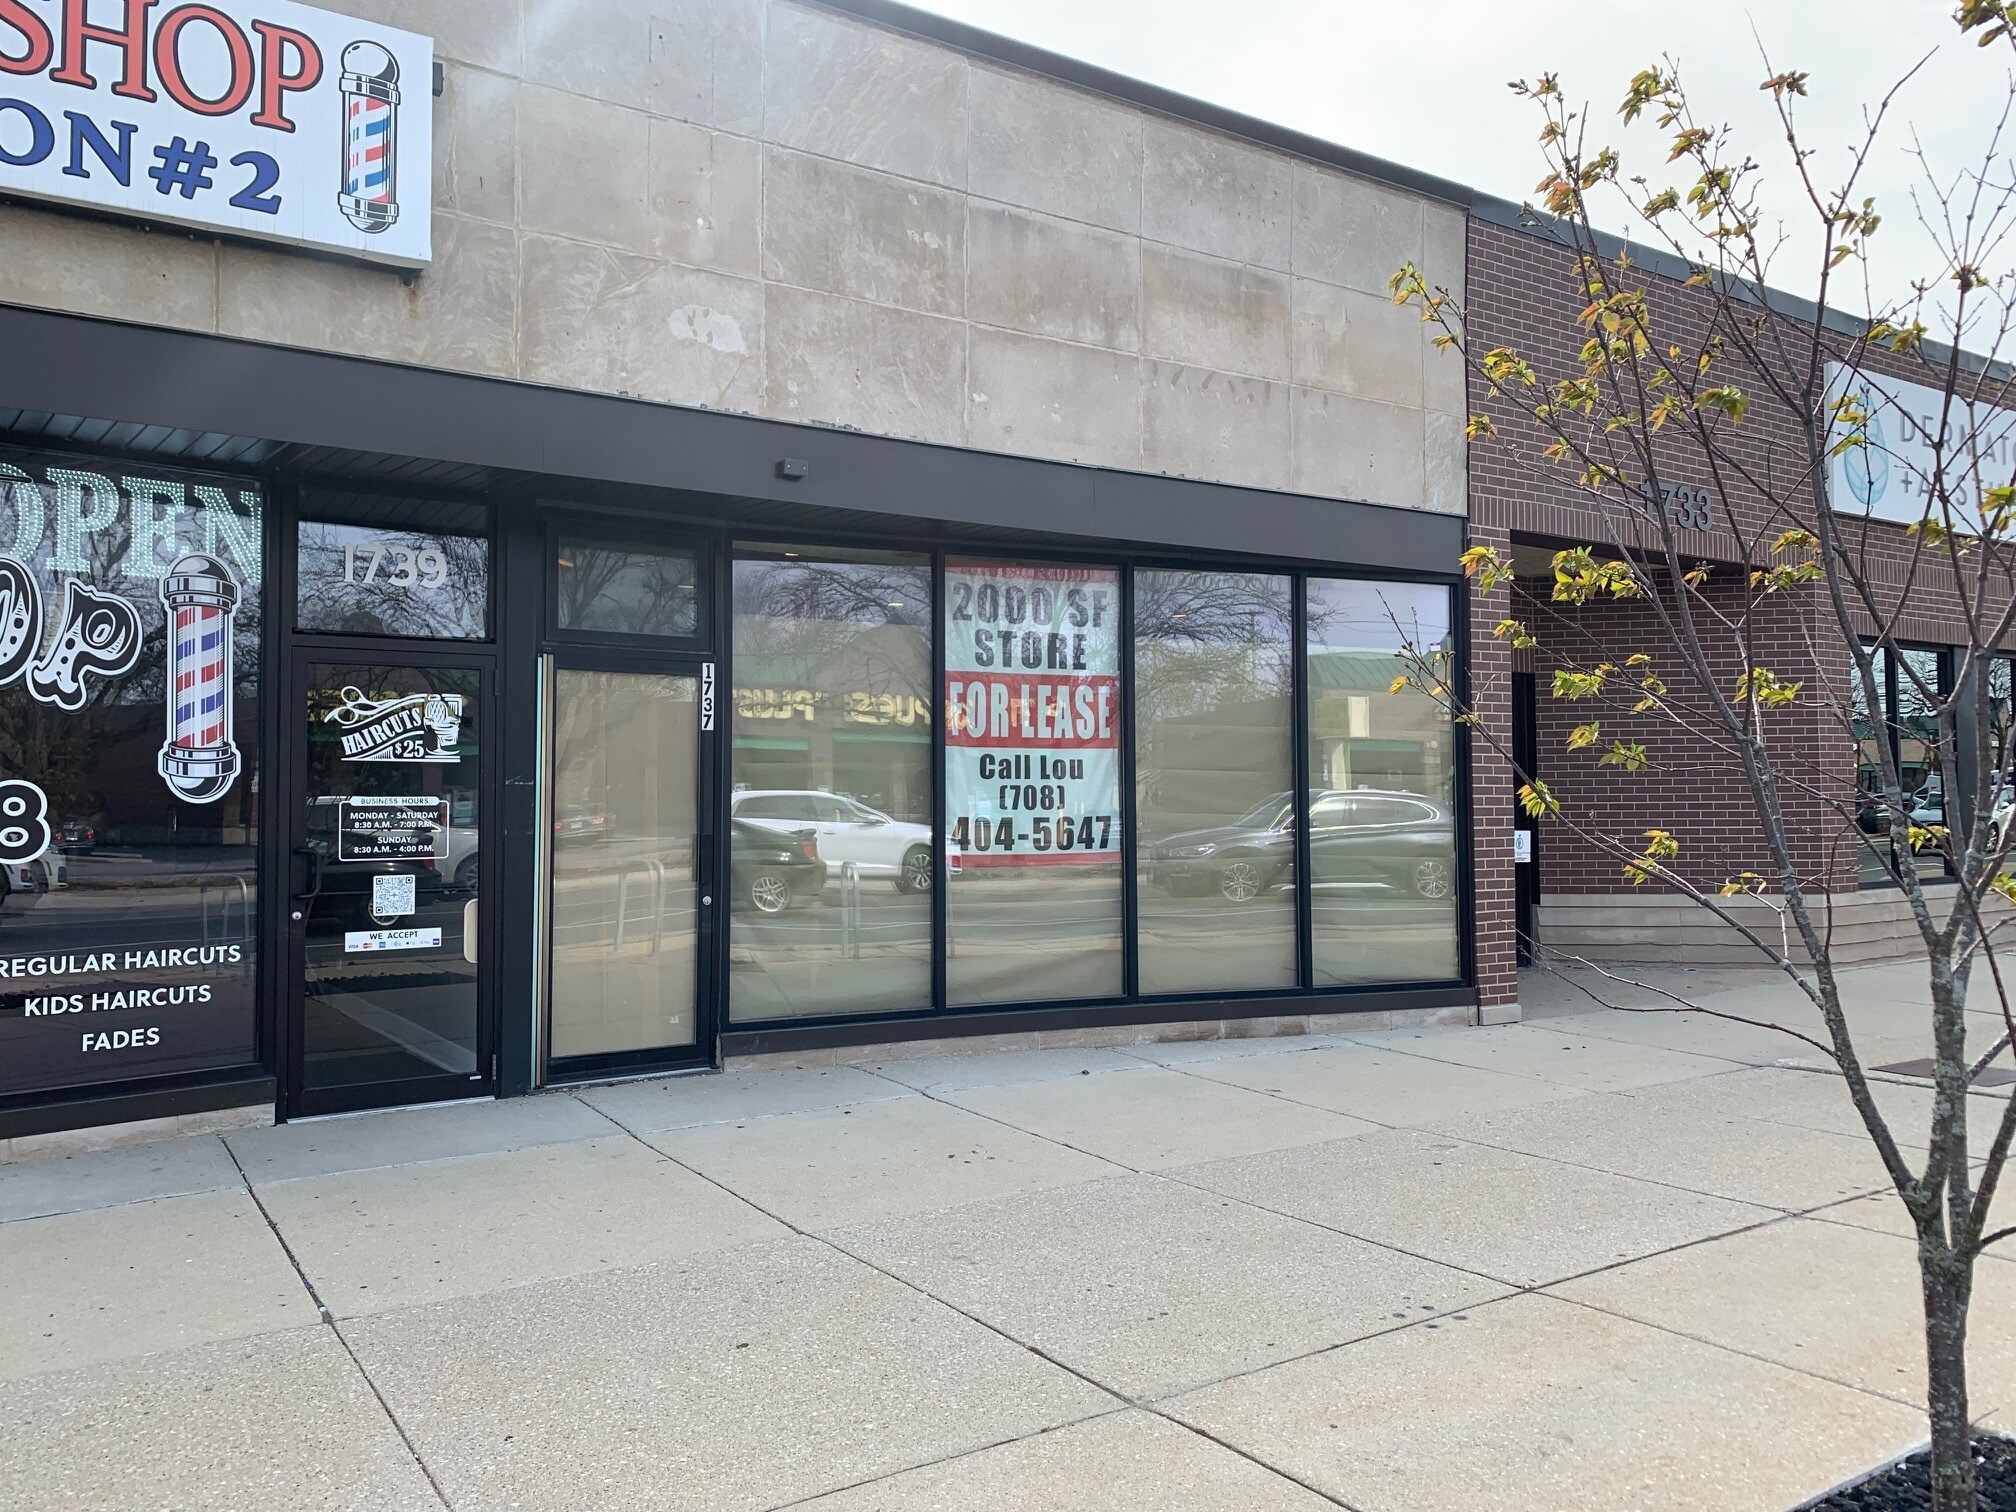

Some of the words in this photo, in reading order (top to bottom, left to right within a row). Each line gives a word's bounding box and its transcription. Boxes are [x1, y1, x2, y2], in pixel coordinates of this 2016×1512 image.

[148, 136, 283, 215] #2
[1639, 479, 1712, 532] 1733
[343, 541, 448, 588] 1739
[952, 581, 1053, 625] 2000
[1067, 588, 1108, 628] SF
[974, 628, 1087, 670] STORE
[702, 663, 714, 730] 1737
[949, 680, 1009, 738] FOR
[1021, 683, 1111, 739] LEASE
[341, 706, 423, 756] HAIRCUTS
[394, 740, 424, 758] $25
[979, 753, 1031, 780] Call
[1040, 754, 1084, 780] Lou
[999, 784, 1065, 811] (708)
[350, 812, 389, 820] MONDAY
[396, 811, 439, 819] SATURDAY
[354, 821, 372, 829] 8:30
[418, 820, 434, 828] P.M.
[377, 836, 411, 844] SUNDAY
[952, 815, 1112, 851] 404-5647
[387, 931, 419, 939] ACCEPT
[0, 952, 116, 978] REGULAR
[124, 944, 241, 970] HAIRCUTS
[24, 994, 84, 1017] KIDS
[91, 984, 212, 1011] HAIRCUTS
[82, 1027, 160, 1052] FADES
